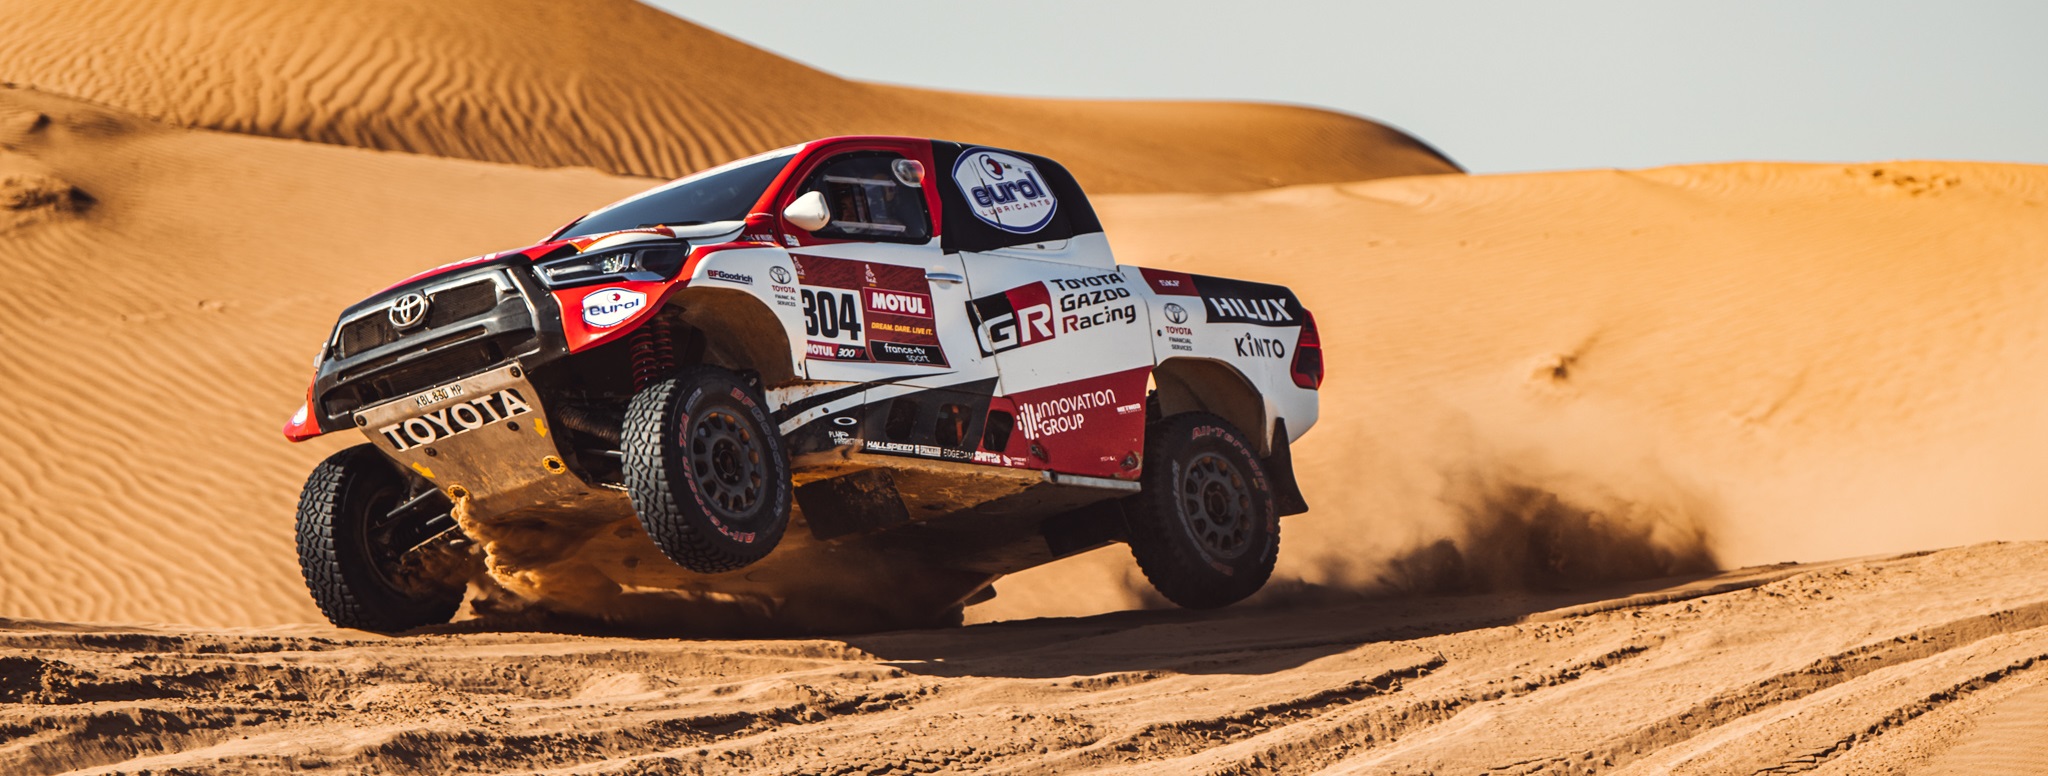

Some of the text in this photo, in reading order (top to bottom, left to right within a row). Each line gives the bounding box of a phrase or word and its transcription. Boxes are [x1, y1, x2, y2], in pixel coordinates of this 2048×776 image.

[971, 171, 1046, 207] eurol
[981, 199, 1051, 216] LUBRICANTS
[707, 269, 753, 283] BFGoodrich
[1050, 273, 1124, 291] TOYOTA
[772, 285, 796, 293] TOYOTA
[590, 298, 639, 316] eurol
[872, 292, 926, 314] MOTUL
[1060, 287, 1130, 312] GAZOO
[800, 289, 862, 341] 304
[1209, 298, 1293, 321] HILUX
[871, 322, 894, 331] DREAM.
[912, 327, 925, 335] LIVE
[977, 304, 1053, 353] GR
[1062, 305, 1136, 334] Racing
[1165, 326, 1192, 336] TOYOTA
[1168, 336, 1192, 345] FINANCIAL
[1171, 344, 1192, 352] SERVICES
[415, 394, 432, 407] KBL
[1037, 389, 1116, 418] INNOVATION
[379, 390, 533, 452] TOYOTA
[1041, 413, 1085, 436] GROUP
[866, 440, 914, 453] HALLSPEED
[943, 448, 973, 460] EDGECAM
